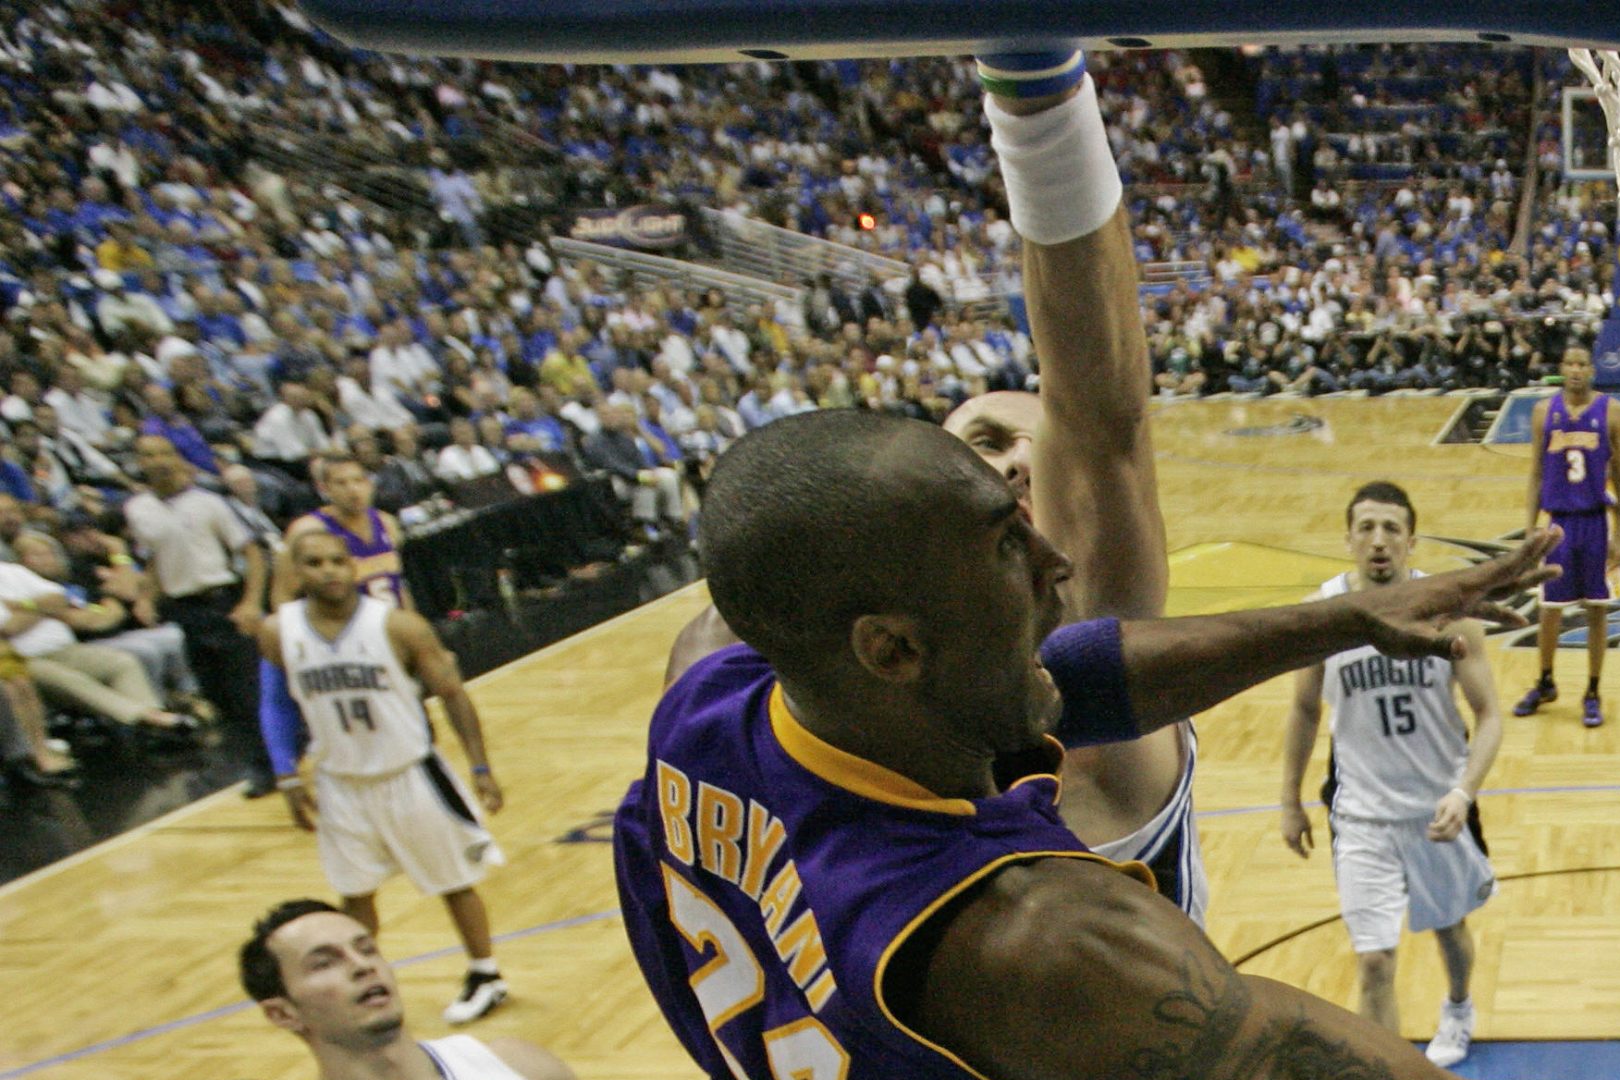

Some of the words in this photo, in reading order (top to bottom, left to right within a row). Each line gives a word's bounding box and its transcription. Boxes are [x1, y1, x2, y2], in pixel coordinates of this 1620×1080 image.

[1565, 449, 1587, 482] 3
[1339, 655, 1434, 698] MAGIC
[1376, 694, 1416, 736] 15
